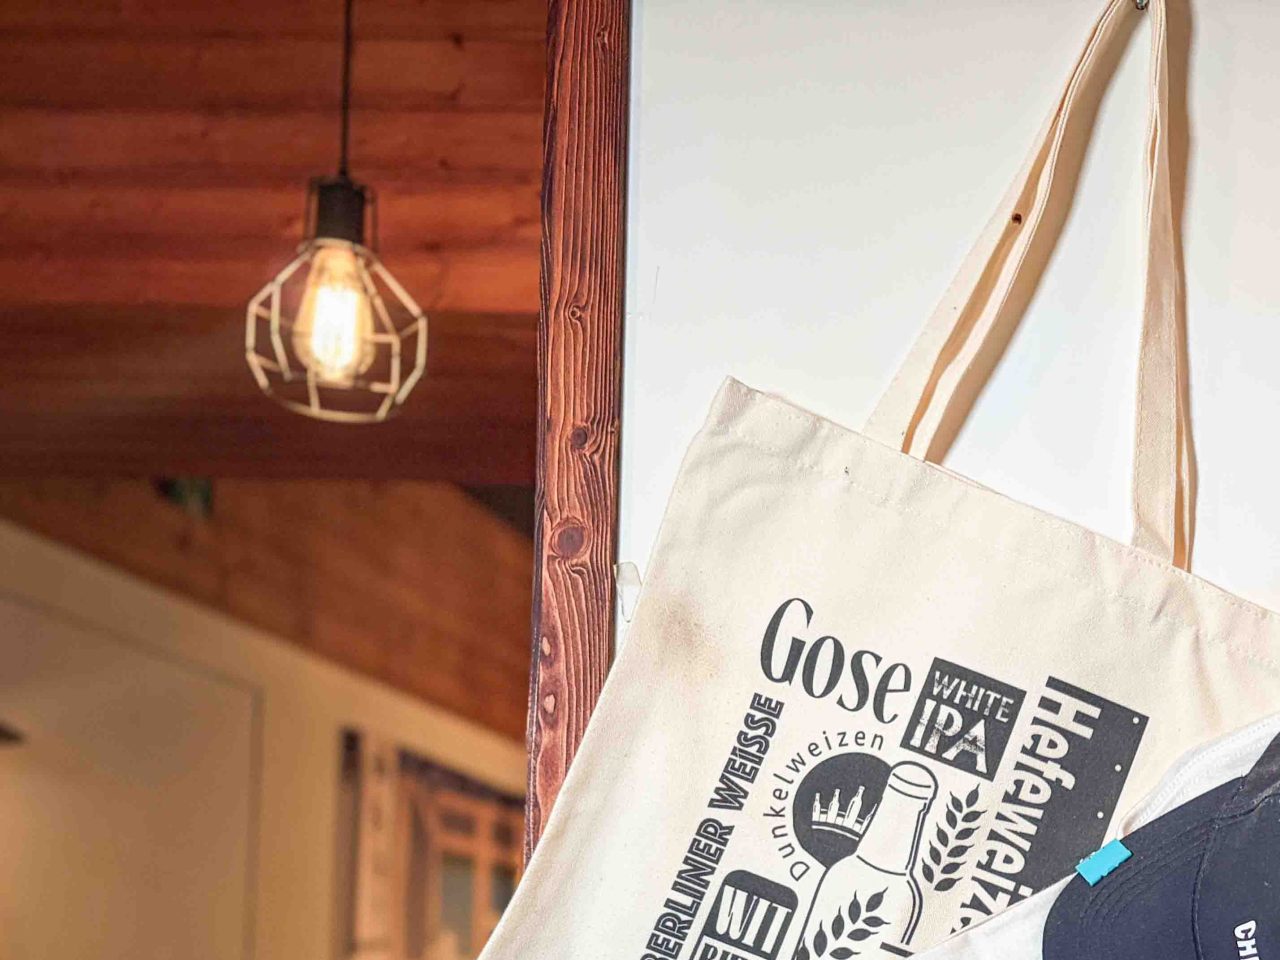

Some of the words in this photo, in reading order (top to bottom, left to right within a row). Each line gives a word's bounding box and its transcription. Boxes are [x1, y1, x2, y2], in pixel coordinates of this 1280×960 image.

[761, 598, 912, 724] Gose
[933, 671, 1014, 723] WHITE
[707, 692, 785, 811] WEISSE
[910, 698, 987, 774] IPA
[763, 729, 884, 881] Dunkelweizen
[715, 885, 792, 954] WIT
